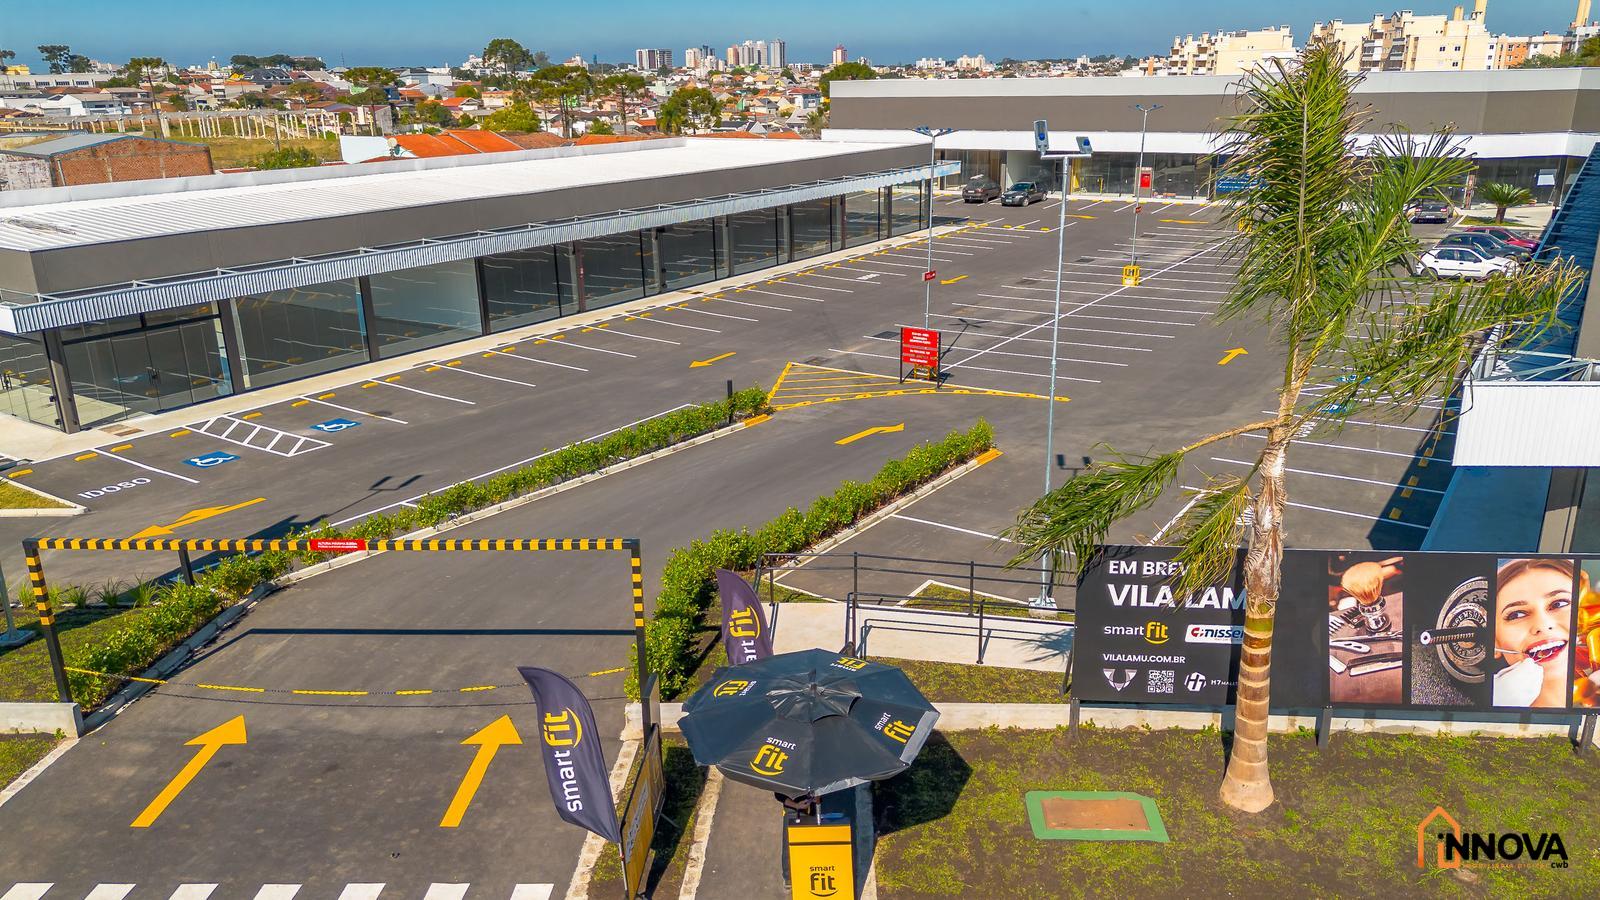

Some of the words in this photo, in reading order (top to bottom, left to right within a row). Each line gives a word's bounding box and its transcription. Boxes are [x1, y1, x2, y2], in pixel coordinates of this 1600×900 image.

[78, 477, 151, 499] IDOSO
[1109, 560, 1137, 575] EM
[1107, 584, 1176, 608] VILA
[1185, 586, 1248, 610] LAM
[728, 606, 755, 637] fit
[1104, 625, 1144, 636] smart
[1145, 621, 1168, 639] fit
[741, 640, 757, 662] art
[1103, 653, 1186, 664] VILALAMU.COM.BR
[544, 710, 574, 748] fit
[874, 712, 892, 731] smart
[882, 719, 916, 744] fit
[765, 736, 797, 750] smart
[753, 744, 789, 771] fit
[554, 749, 583, 813] smart
[810, 873, 837, 891] fit
